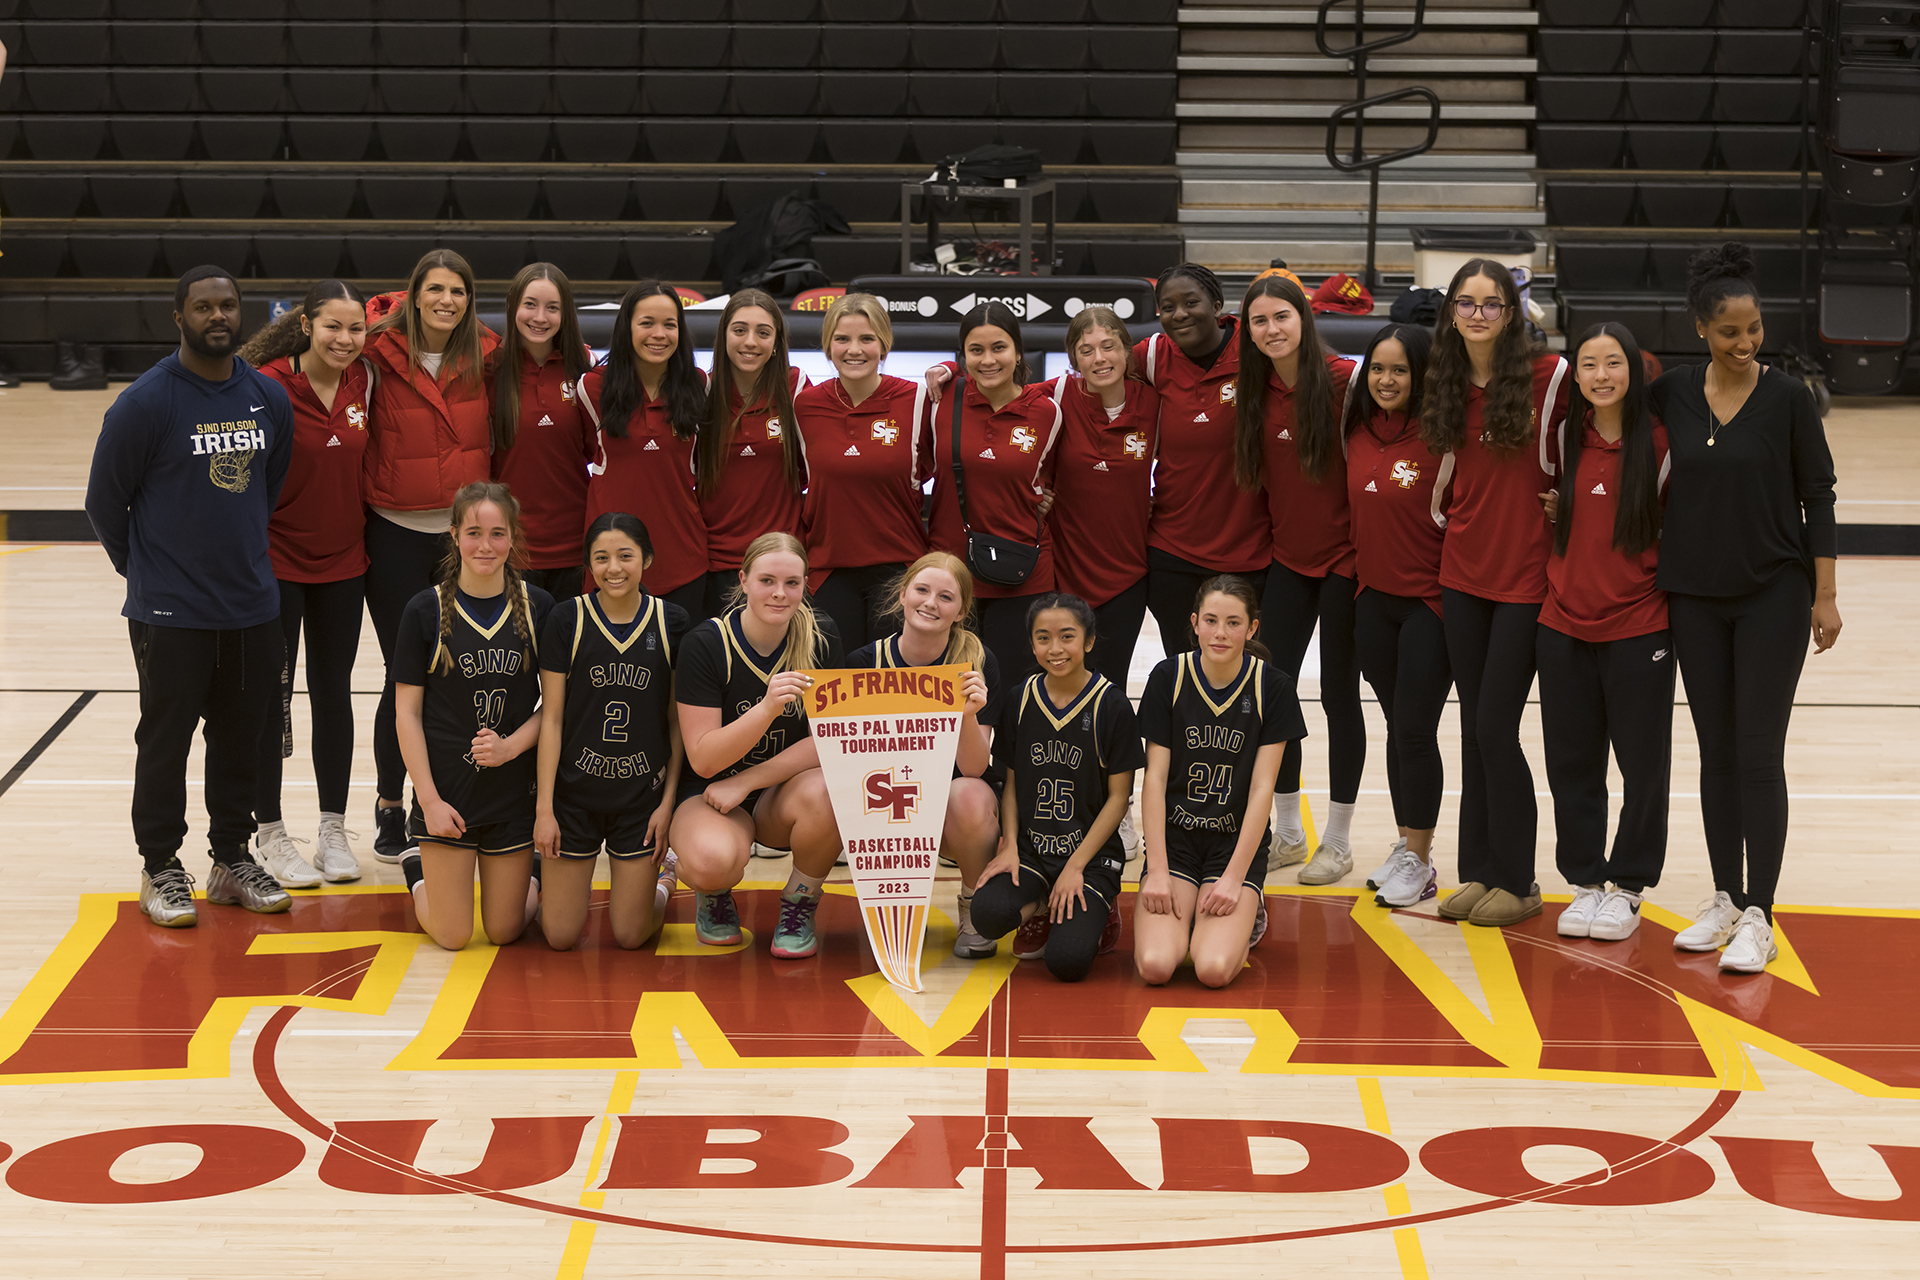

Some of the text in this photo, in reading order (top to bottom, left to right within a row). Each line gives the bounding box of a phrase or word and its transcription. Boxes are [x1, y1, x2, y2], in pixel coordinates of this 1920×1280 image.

[889, 301, 917, 312] BONUS
[196, 420, 257, 434] SJND FOLSOM
[871, 418, 899, 446] SF
[1010, 426, 1037, 454] SF
[190, 429, 266, 455] IRISH
[1123, 432, 1148, 460] SF
[1390, 460, 1420, 489] SF
[458, 648, 522, 679] SJND
[589, 662, 651, 690] SJND
[815, 677, 847, 713] ST.
[852, 671, 955, 706] FRANCIS
[473, 688, 507, 730] 20
[602, 700, 630, 742] 2
[817, 717, 957, 738] GIRLS PAL VARISTY
[1185, 725, 1245, 754] SJND
[840, 735, 935, 755] TOURNAMENT
[1030, 740, 1083, 770] SJND
[575, 747, 650, 779] IRISH
[866, 772, 918, 820] SF
[1187, 762, 1233, 805] 24
[1034, 778, 1075, 822] 25
[848, 837, 937, 854] BASKETBALL
[1027, 828, 1085, 857] RISH
[855, 854, 931, 870] CHAMPIONS
[878, 883, 910, 894] 2023
[0, 1114, 1920, 1221] OUBADOU
